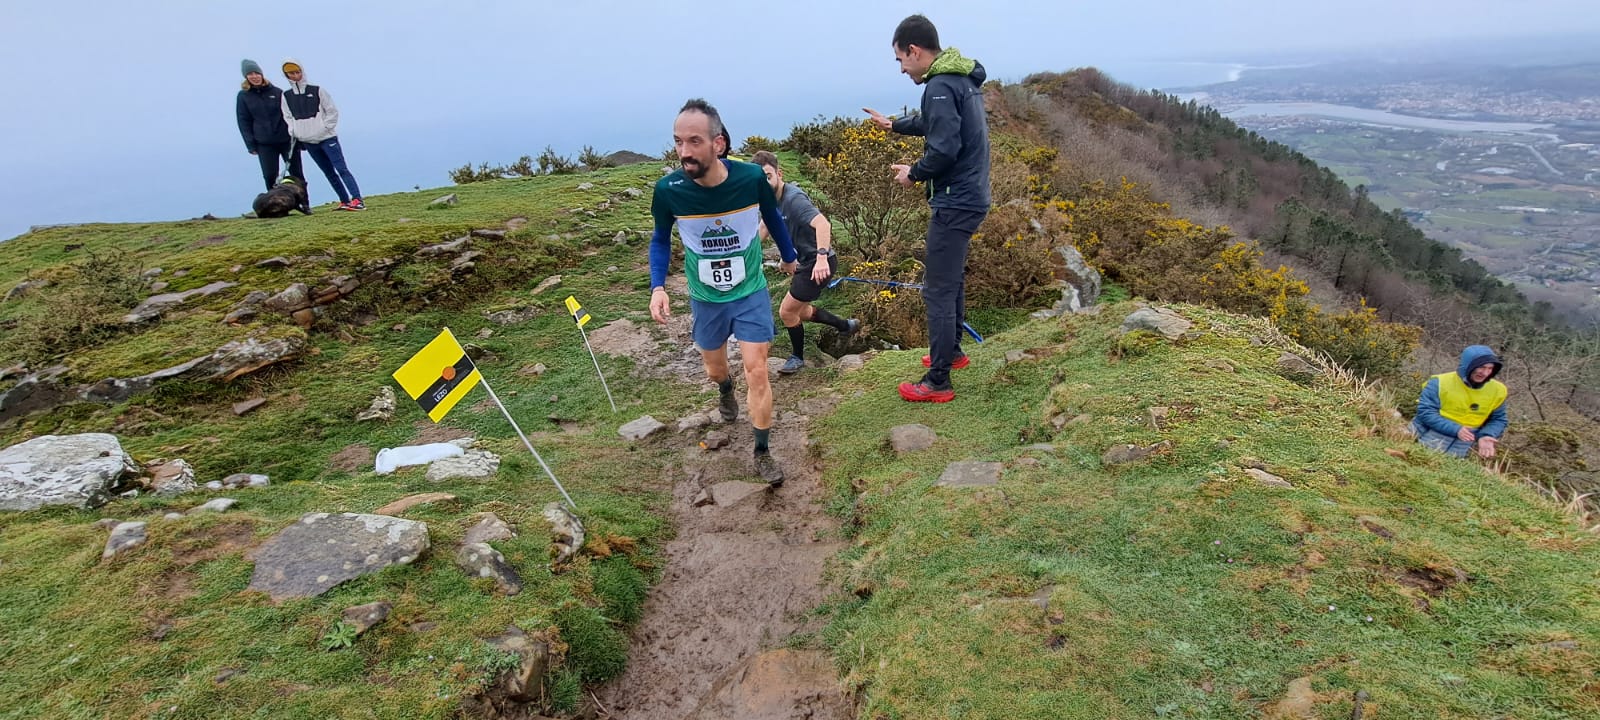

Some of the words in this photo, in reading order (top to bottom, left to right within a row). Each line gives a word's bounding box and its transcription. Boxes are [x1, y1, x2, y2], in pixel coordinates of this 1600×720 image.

[701, 236, 740, 248] XOXOLUR
[713, 269, 732, 283] 69
[434, 389, 447, 402] LEZO
